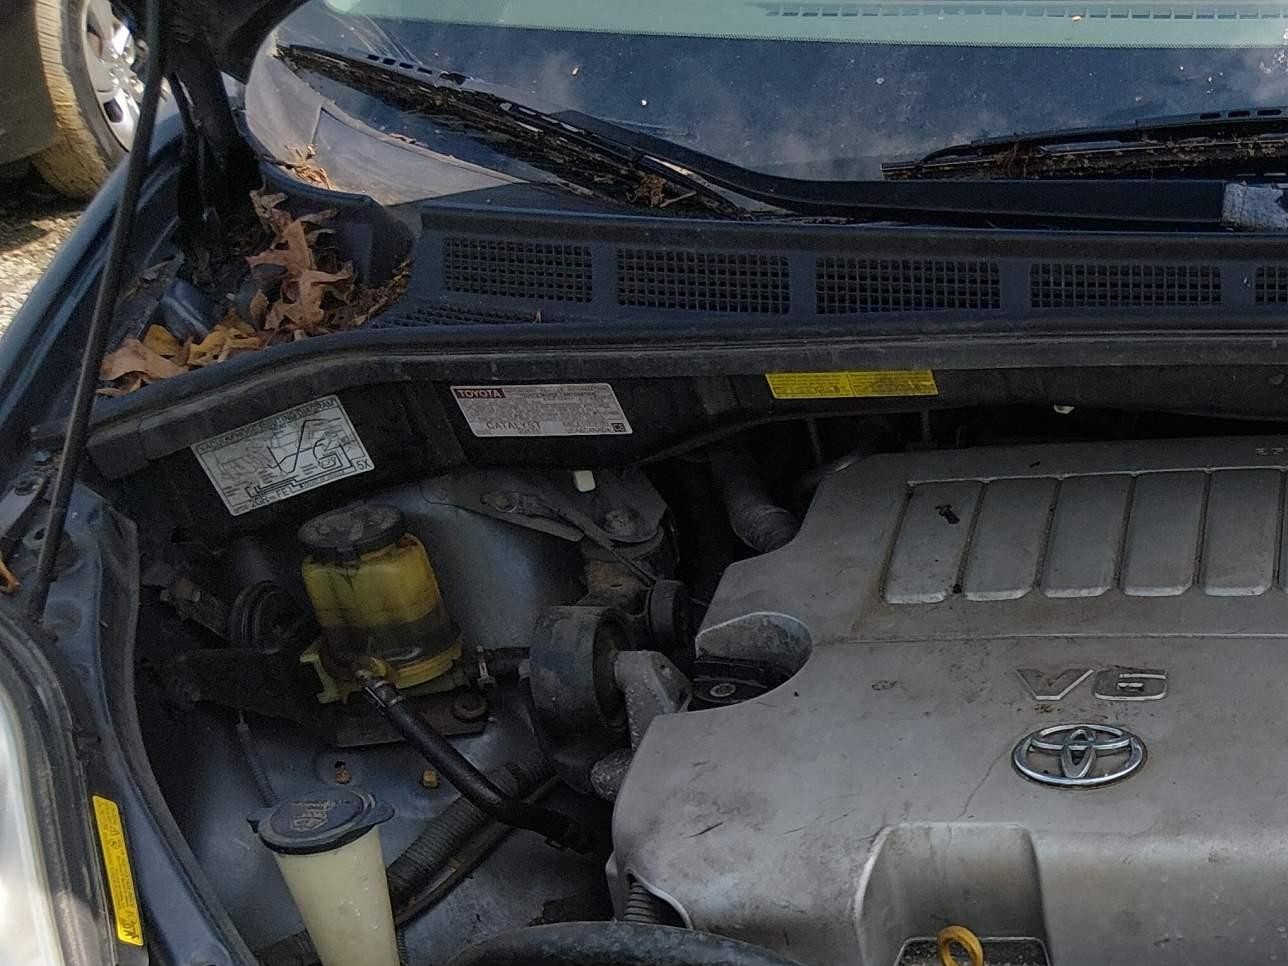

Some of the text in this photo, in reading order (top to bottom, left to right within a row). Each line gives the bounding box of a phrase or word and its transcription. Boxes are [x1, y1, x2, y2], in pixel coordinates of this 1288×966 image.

[458, 389, 502, 399] TOYOTA
[486, 421, 542, 430] CATALYST
[356, 459, 373, 472] 5X
[1014, 667, 1168, 702] V6
